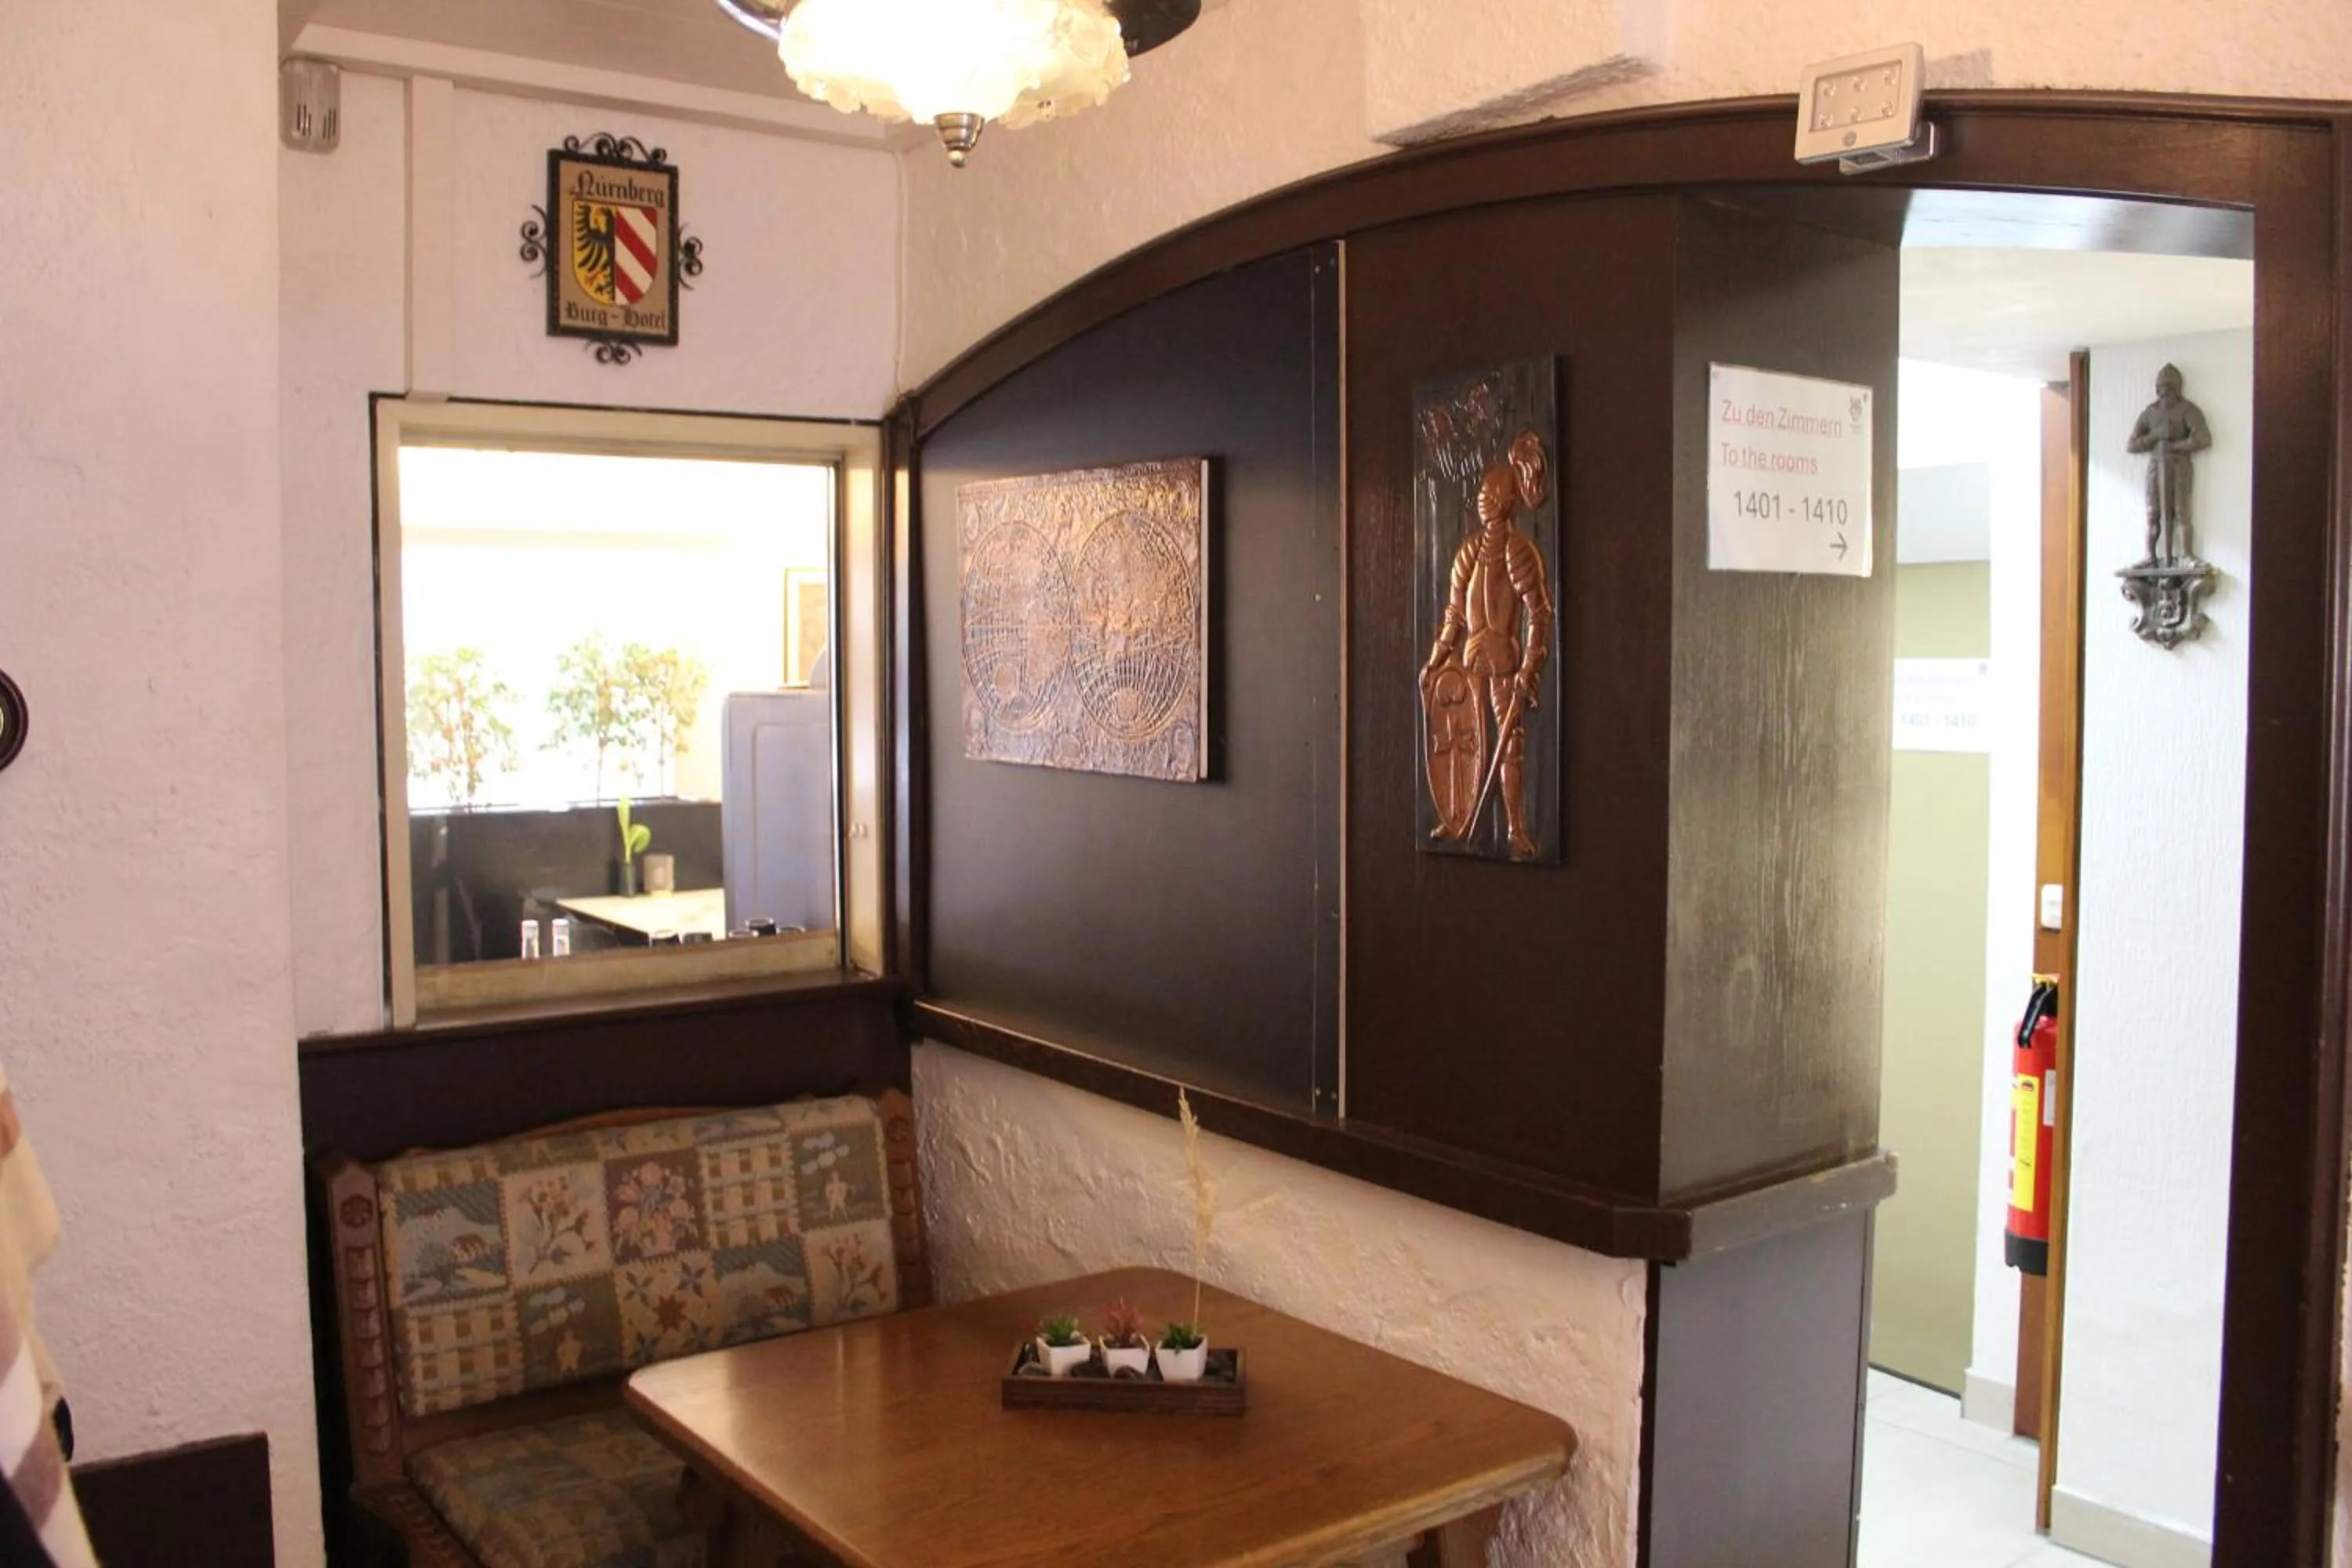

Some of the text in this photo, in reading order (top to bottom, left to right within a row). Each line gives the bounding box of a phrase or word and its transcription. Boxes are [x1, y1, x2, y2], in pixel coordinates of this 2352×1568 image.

[565, 301, 608, 326] Burg
[619, 306, 666, 330] Hotel
[1722, 400, 1741, 423] Zu
[1746, 404, 1774, 427] den
[1777, 408, 1842, 437] Zimmern
[1721, 442, 1818, 474] To the rooms
[1733, 490, 1780, 521] 1401
[1802, 496, 1849, 525] 1410
